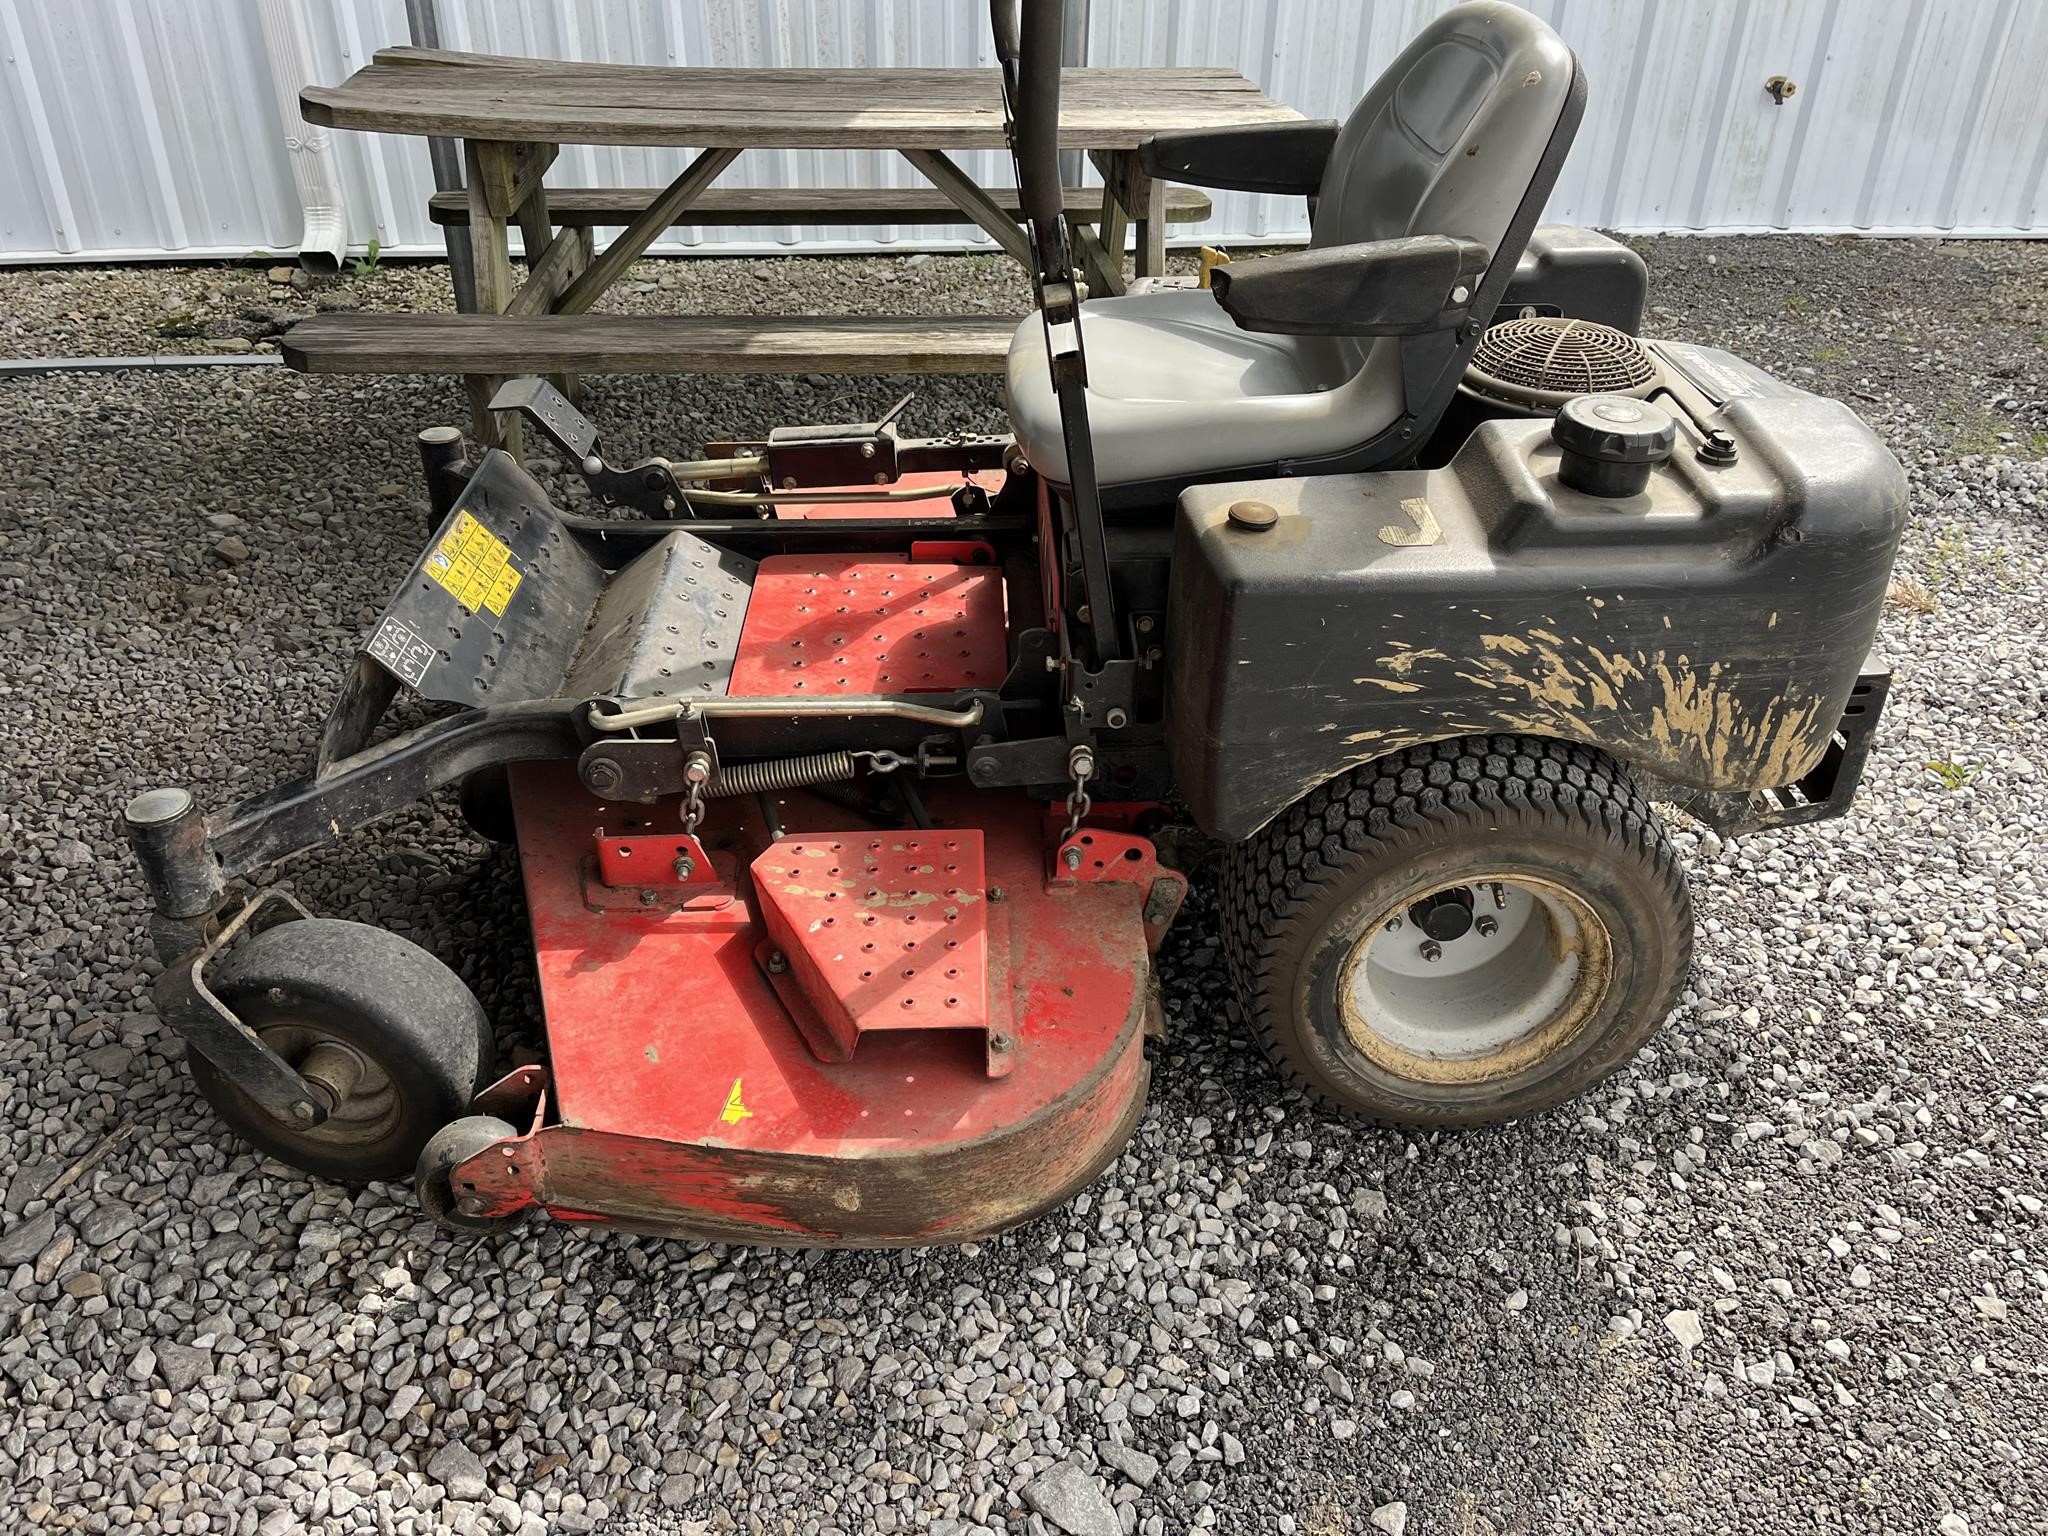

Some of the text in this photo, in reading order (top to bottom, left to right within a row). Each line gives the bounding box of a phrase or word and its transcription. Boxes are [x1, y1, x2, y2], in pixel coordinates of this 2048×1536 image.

[1559, 1008, 1639, 1081] KENDA
[1313, 1045, 1463, 1118] SUPER TURF
